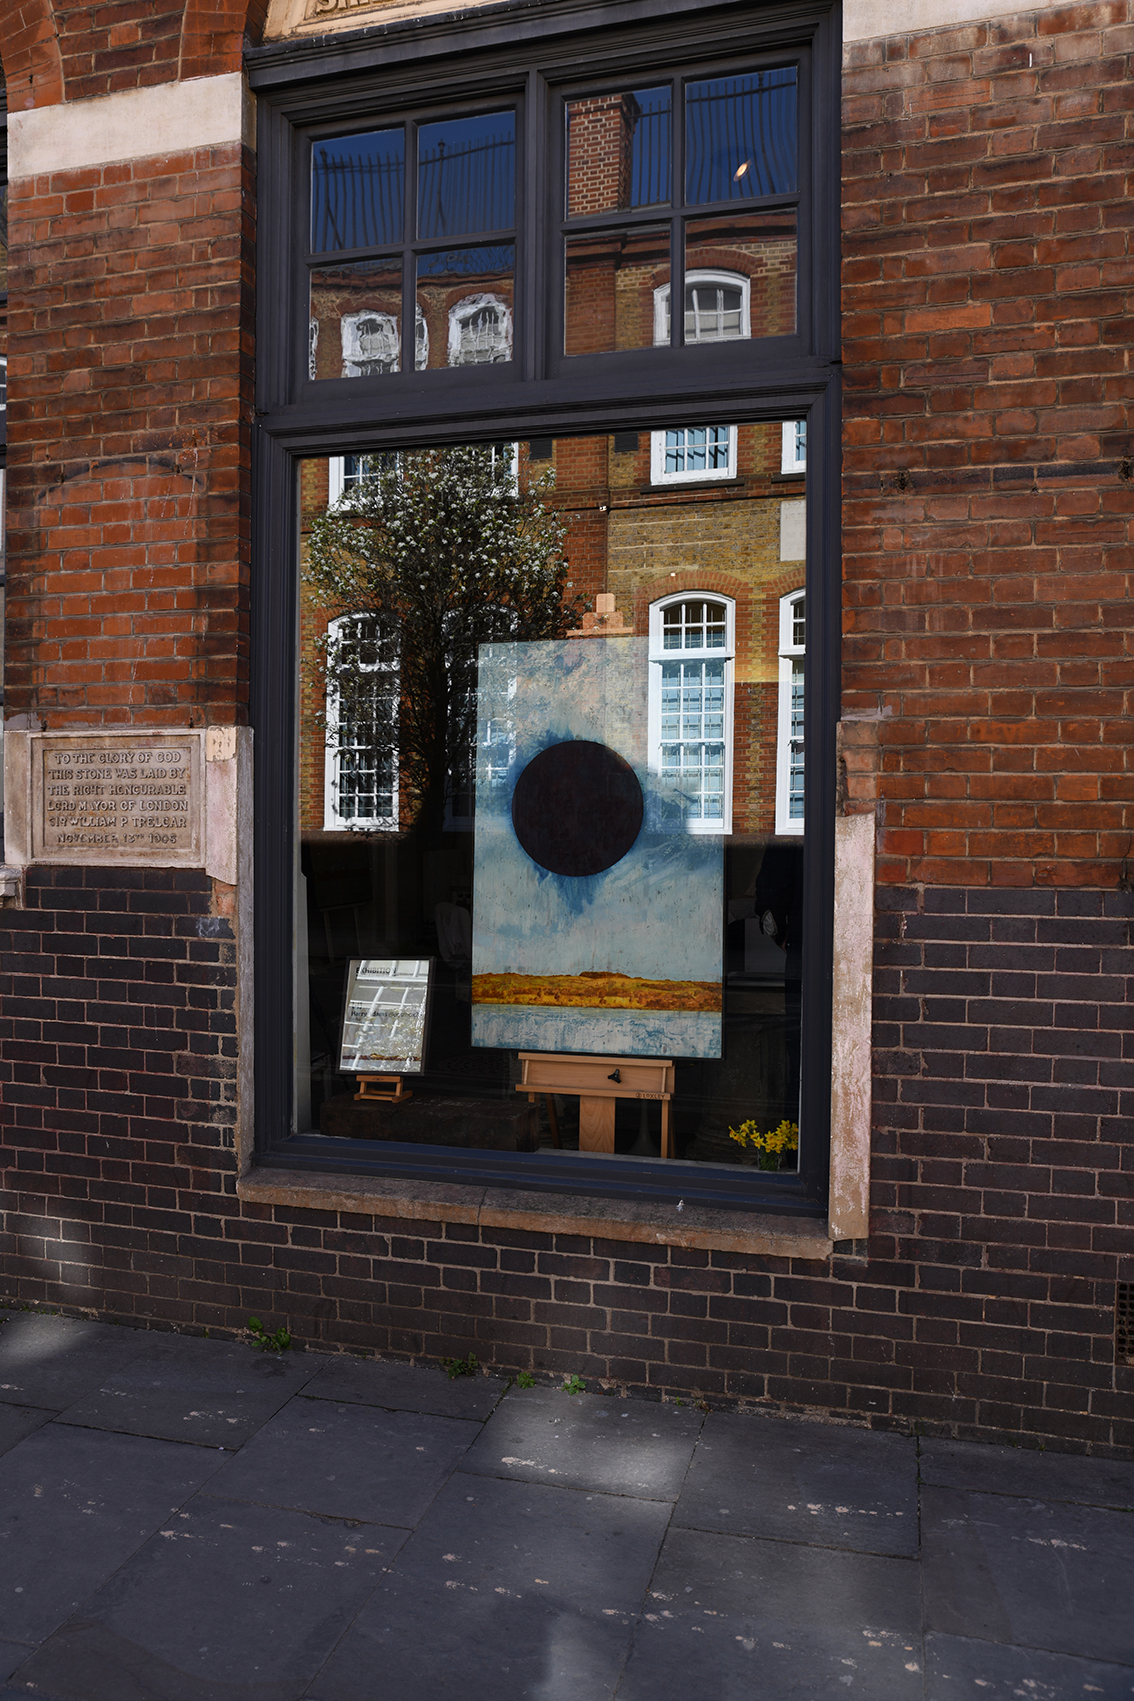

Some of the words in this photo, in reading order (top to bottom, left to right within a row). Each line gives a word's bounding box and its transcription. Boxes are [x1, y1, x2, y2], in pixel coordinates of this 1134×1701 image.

[55, 754, 70, 764] TO
[73, 753, 96, 764] THE
[98, 752, 135, 764] GLORY
[137, 752, 152, 763] OF
[156, 751, 181, 763] GOD
[48, 769, 73, 780] THIS
[75, 769, 112, 780] STONE
[115, 768, 137, 779] WAS
[140, 768, 166, 779] LAID
[169, 768, 186, 779] BY
[48, 785, 70, 796] THE
[73, 785, 105, 796] RIGHT
[109, 784, 186, 796] HONOURABLE
[47, 800, 76, 811] LORD
[78, 800, 116, 811] MAYOR
[120, 800, 136, 811] OF
[139, 800, 188, 811] LONDON
[49, 816, 68, 827] SIR
[70, 816, 117, 827] WILLIAM
[120, 816, 128, 828] P
[132, 816, 186, 828] TRELOAR
[57, 832, 119, 843] NOVEMBER
